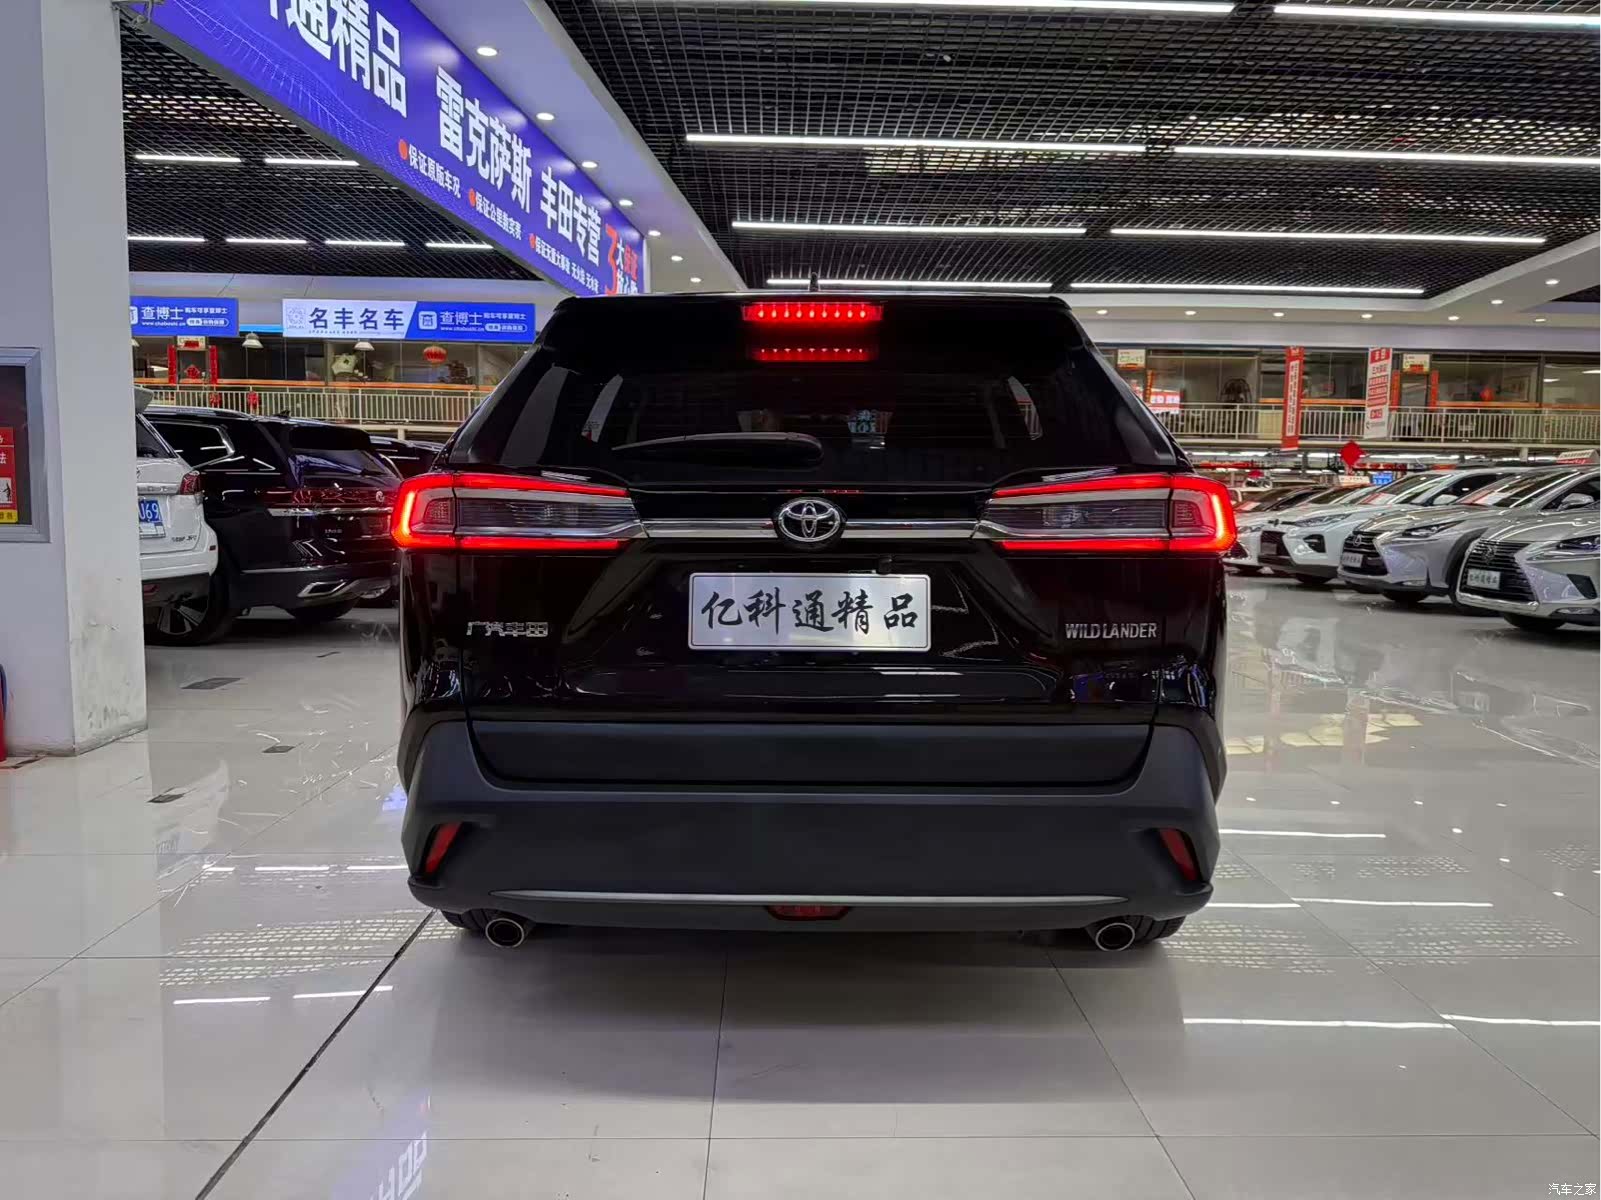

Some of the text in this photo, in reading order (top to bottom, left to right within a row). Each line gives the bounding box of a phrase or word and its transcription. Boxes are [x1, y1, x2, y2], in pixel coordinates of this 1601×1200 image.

[269, 0, 601, 266] 通精品 雷克萨斯 丰田专营
[141, 305, 184, 320] 查博士
[308, 307, 404, 331] 名丰名车
[440, 311, 483, 326] 查博士
[701, 587, 918, 634] 亿科通精品
[466, 621, 548, 637] 广汽丰田
